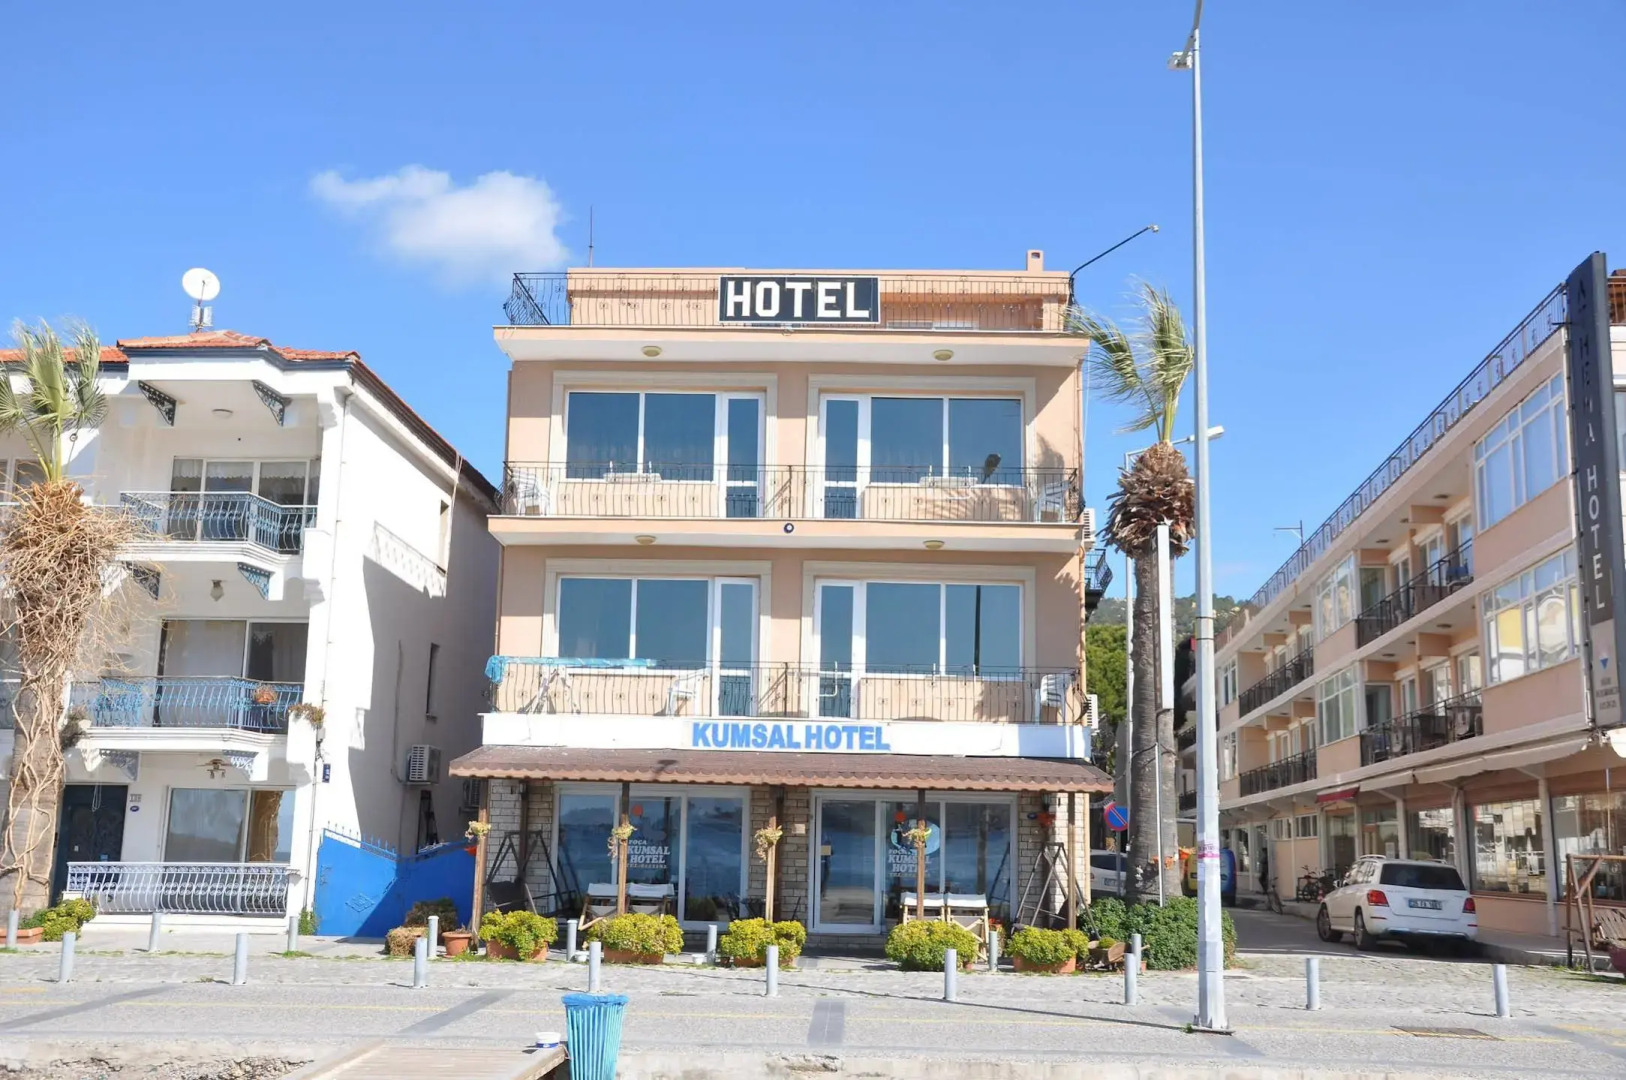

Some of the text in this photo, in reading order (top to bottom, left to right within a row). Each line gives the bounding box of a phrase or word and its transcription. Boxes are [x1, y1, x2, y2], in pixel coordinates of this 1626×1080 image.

[726, 281, 870, 318] HOTEL
[1587, 464, 1605, 609] HOTEL
[692, 722, 891, 751] KUMSAL HOTEL
[627, 845, 671, 855] KUMSAL
[630, 855, 666, 864] HOTEL
[888, 854, 932, 864] KUMSL
